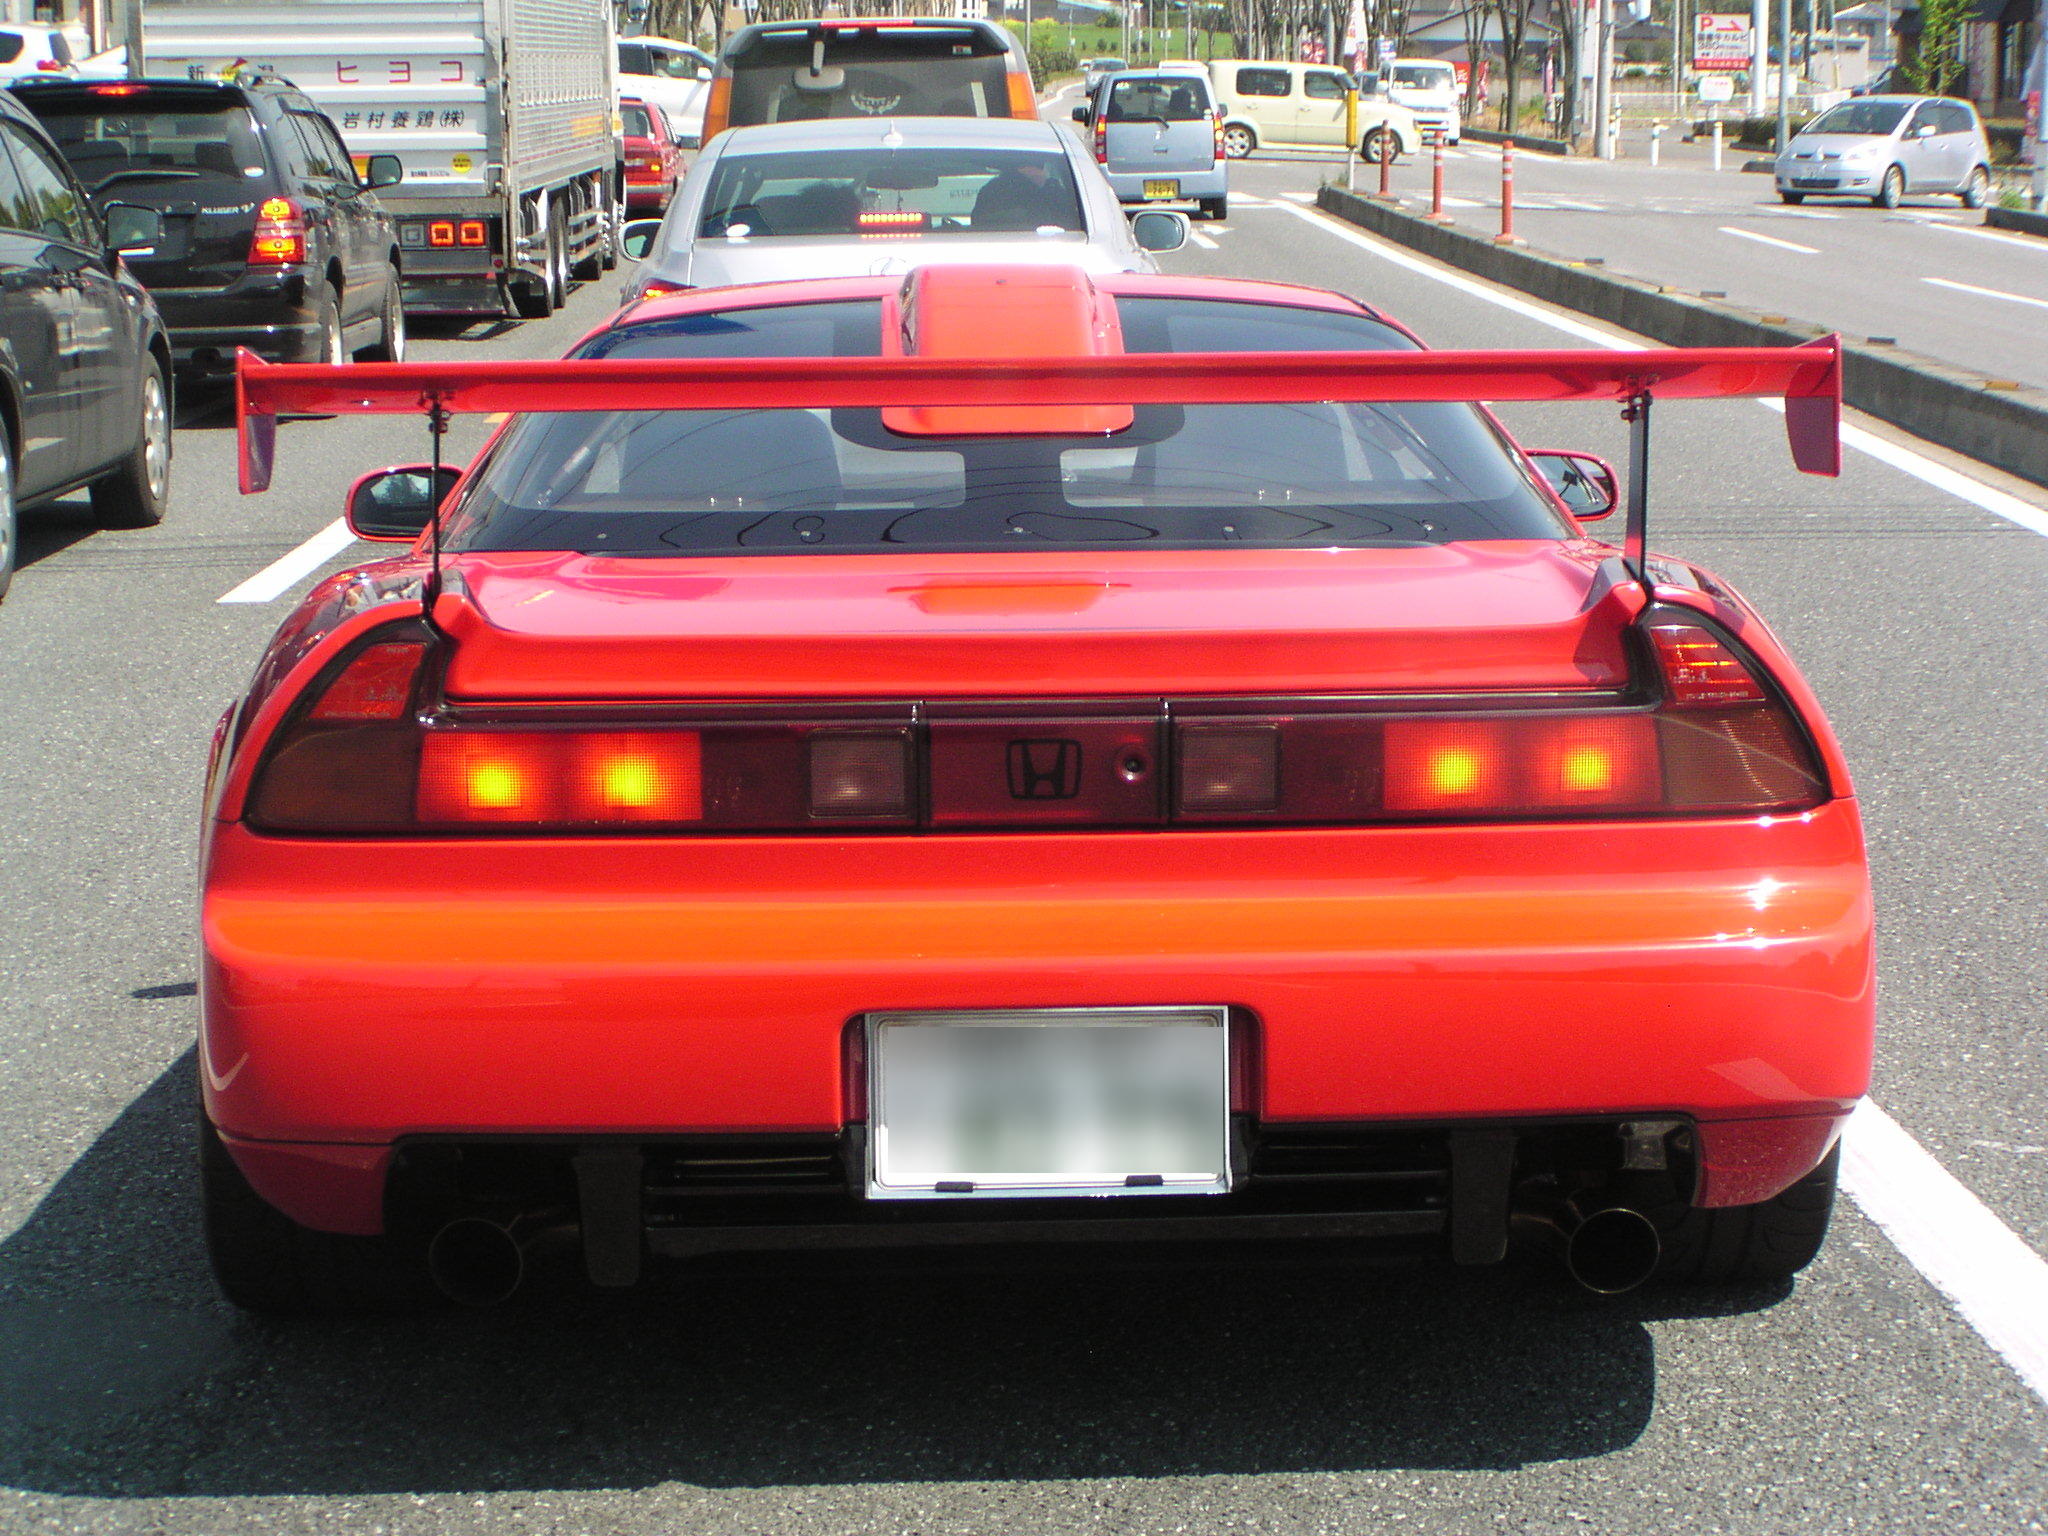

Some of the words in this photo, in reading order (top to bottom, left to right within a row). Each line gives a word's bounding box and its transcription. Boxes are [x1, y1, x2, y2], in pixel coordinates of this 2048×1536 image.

[1701, 16, 1714, 31] P
[337, 61, 463, 83] ヒヨコ
